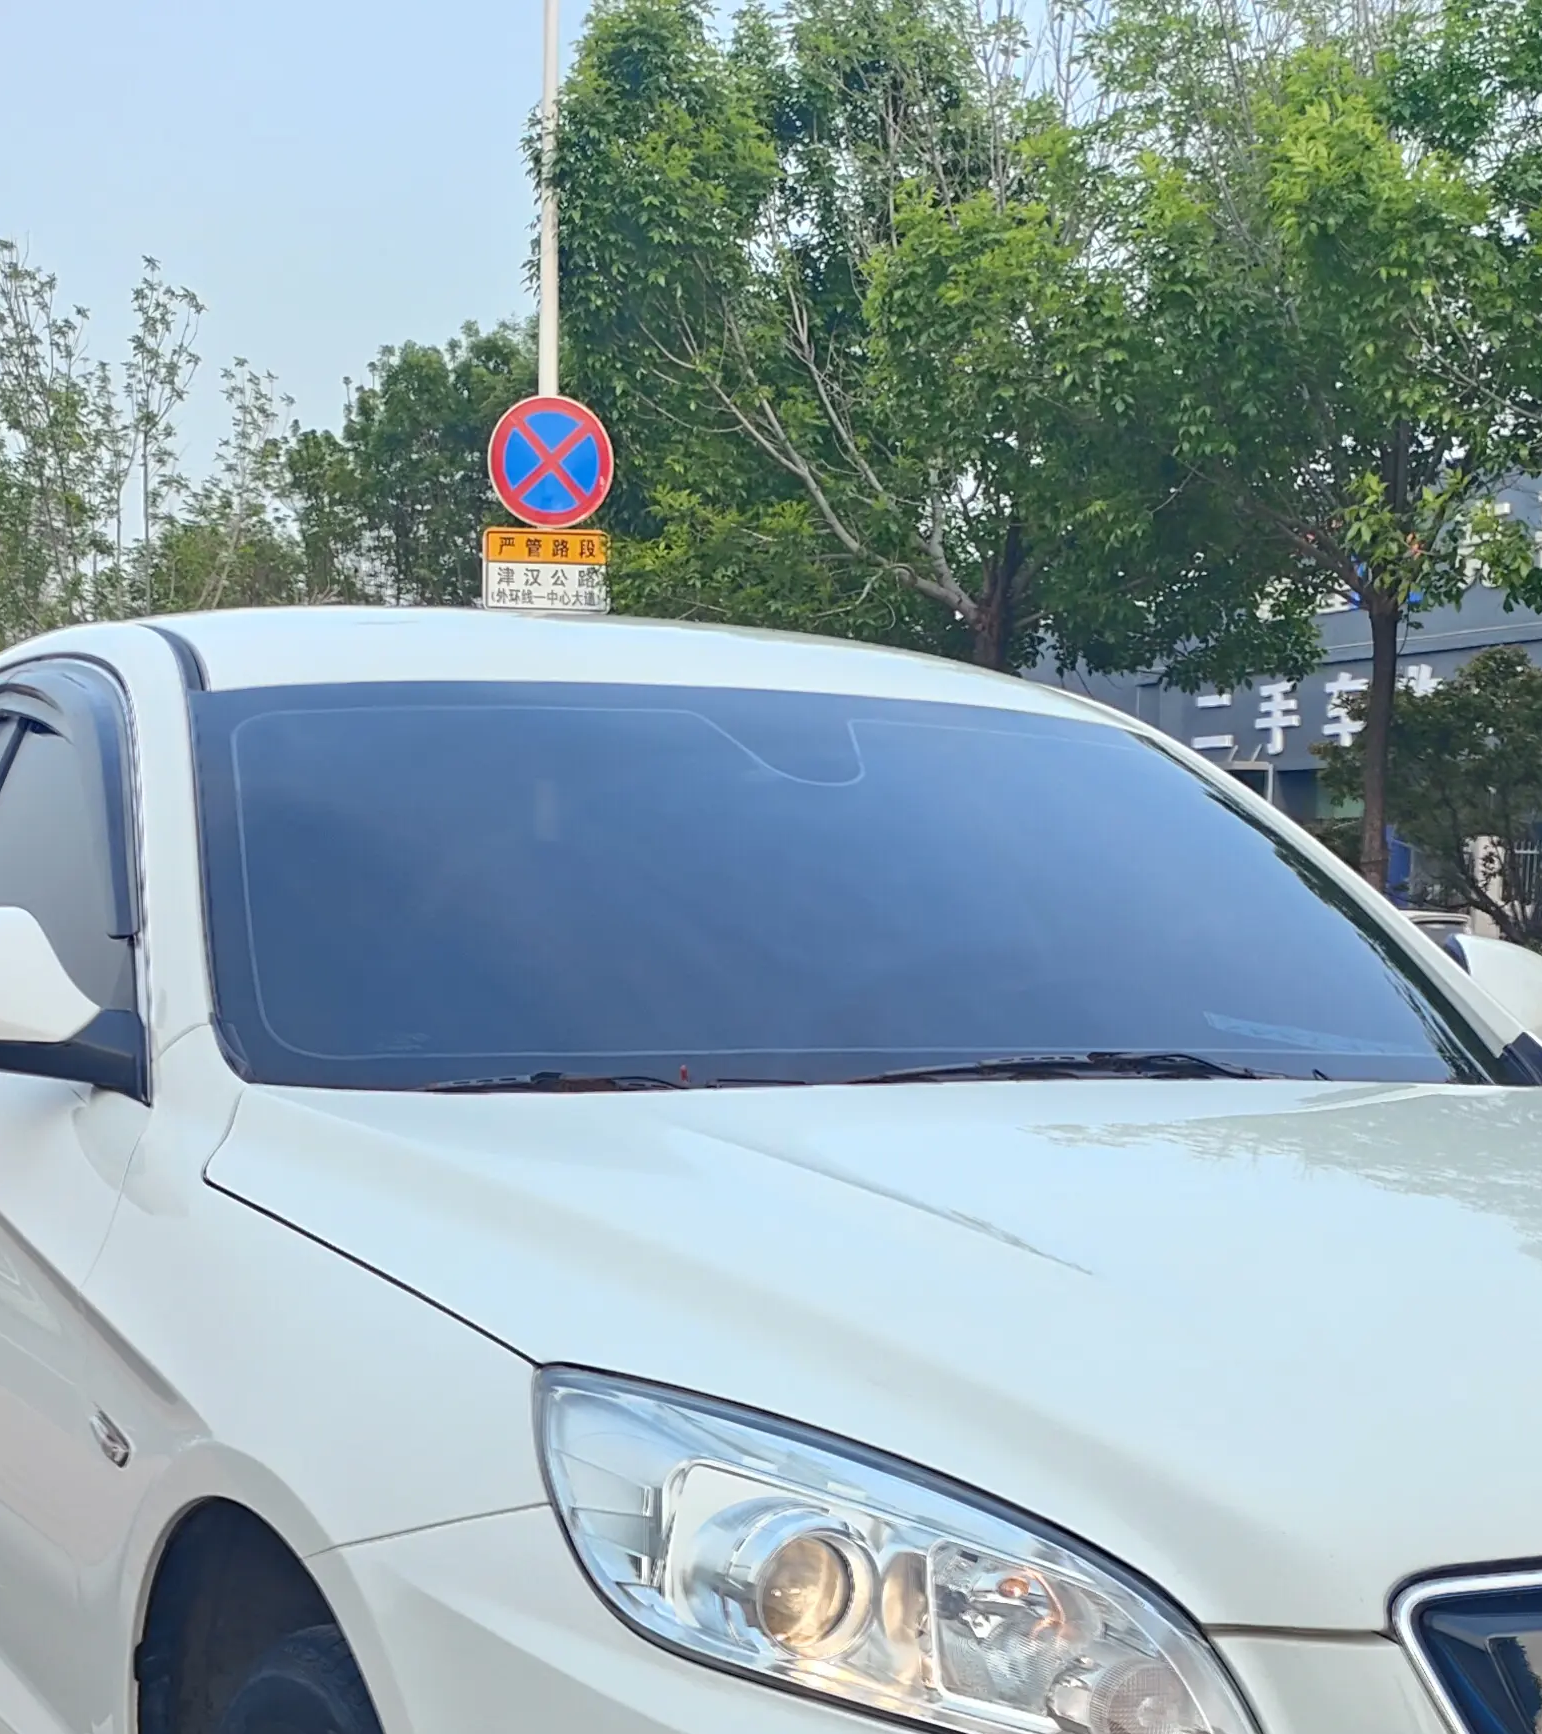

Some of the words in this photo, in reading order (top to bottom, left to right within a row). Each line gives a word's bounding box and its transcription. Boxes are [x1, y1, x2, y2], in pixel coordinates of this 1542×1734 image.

[499, 537, 595, 557] 严管路段
[497, 567, 597, 588] 津汉公路
